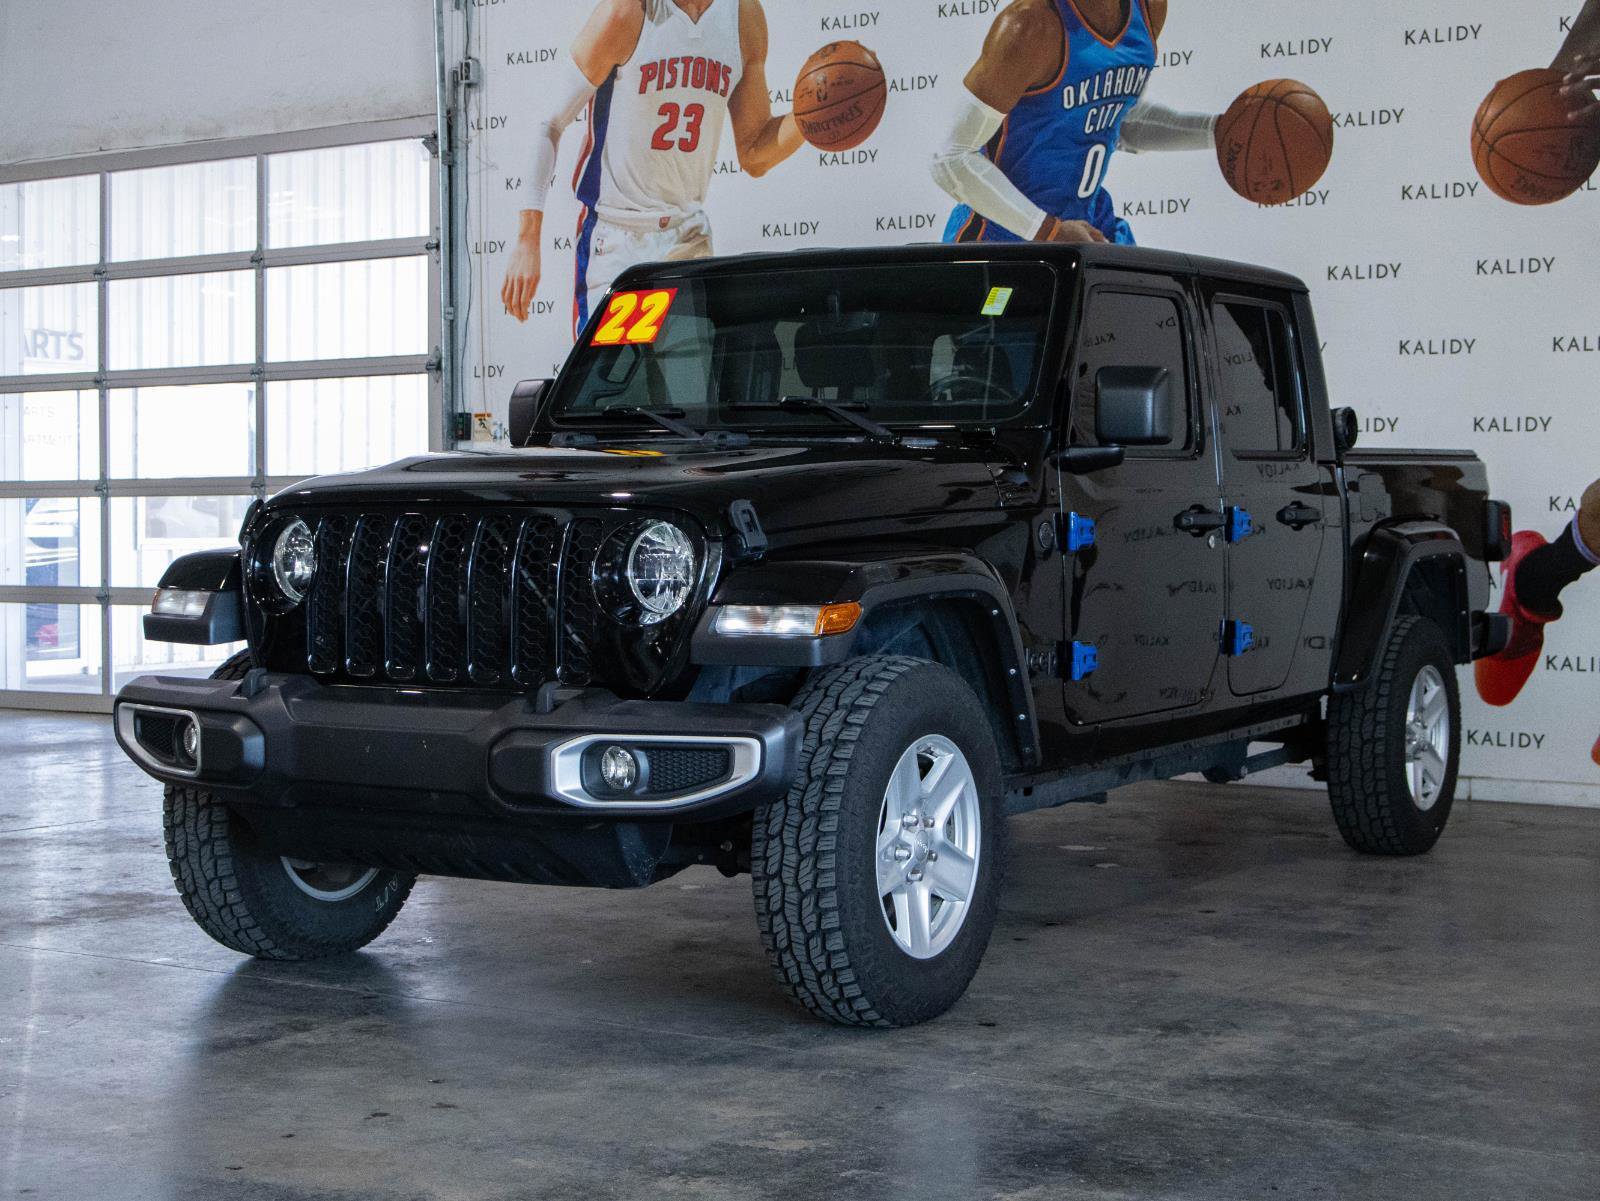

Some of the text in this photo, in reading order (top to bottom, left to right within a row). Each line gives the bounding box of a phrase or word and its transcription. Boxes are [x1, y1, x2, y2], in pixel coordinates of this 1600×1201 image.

[938, 0, 999, 18] KALIDY
[821, 12, 880, 31] KALIDY
[1404, 24, 1482, 45] KALIDY
[507, 48, 557, 65] KALIDY
[1260, 38, 1333, 58] KALIDY
[638, 56, 732, 98] PISTONS
[889, 75, 938, 93] ALIDY
[471, 116, 507, 130] LIDY
[651, 102, 705, 153] 23
[1084, 103, 1123, 134] CITY
[1330, 109, 1404, 128] KALIDY
[819, 149, 878, 167] KALIDY
[1401, 182, 1478, 200] KALIDY
[1123, 198, 1191, 217] KALIDY
[762, 221, 819, 237] KALIDY
[876, 214, 936, 231] KALIDY
[475, 241, 505, 254] LIDY
[1327, 263, 1401, 280] KALIDY
[1476, 257, 1555, 275] KALIDY
[594, 292, 669, 343] 22
[1399, 339, 1475, 355] KALIDY
[474, 366, 504, 378] LIDY
[1473, 416, 1552, 432] KALIDY
[1546, 655, 1600, 672] KALI
[1467, 729, 1545, 750] KALIDY
